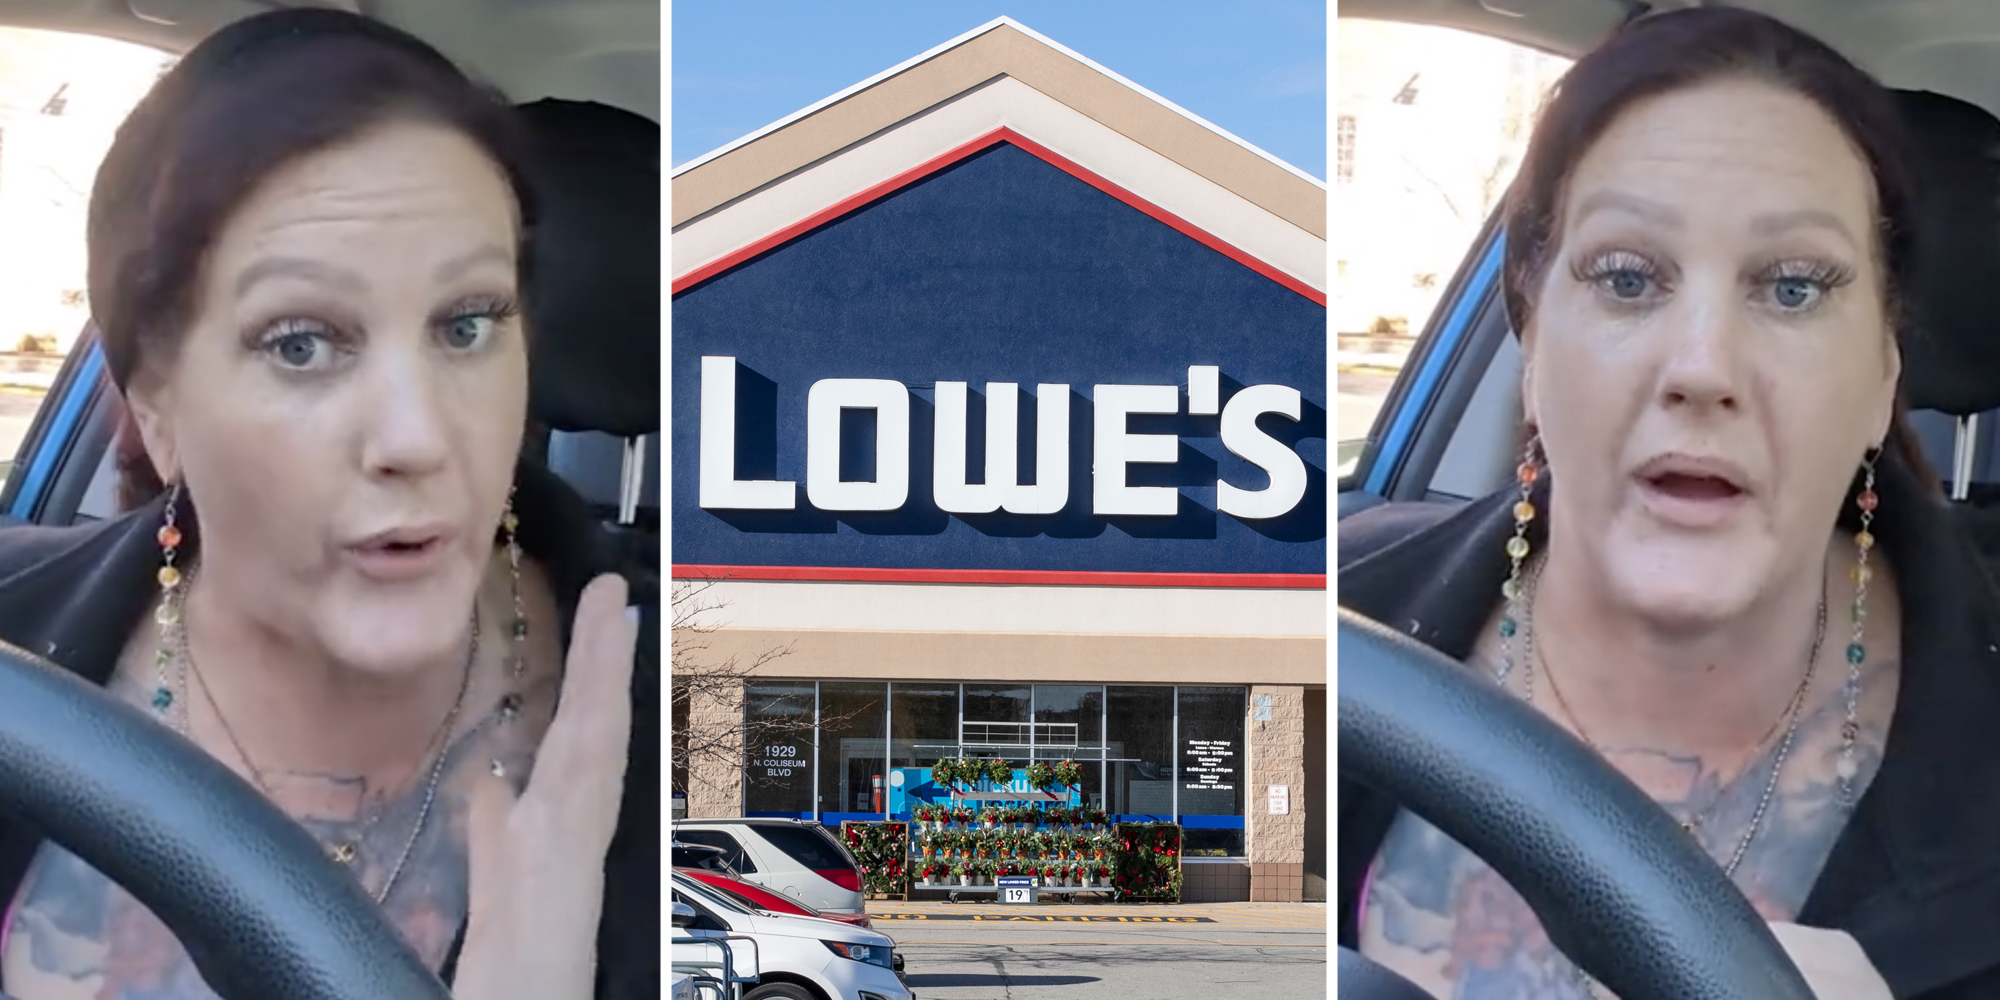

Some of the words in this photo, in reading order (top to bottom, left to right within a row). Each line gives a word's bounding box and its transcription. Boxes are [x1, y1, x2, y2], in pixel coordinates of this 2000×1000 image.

[699, 356, 1307, 519] LOWE'S
[765, 745, 796, 757] 1929
[763, 759, 806, 768] COLISEUM
[767, 768, 792, 777] BLVD
[973, 914, 1198, 922] PARKING
